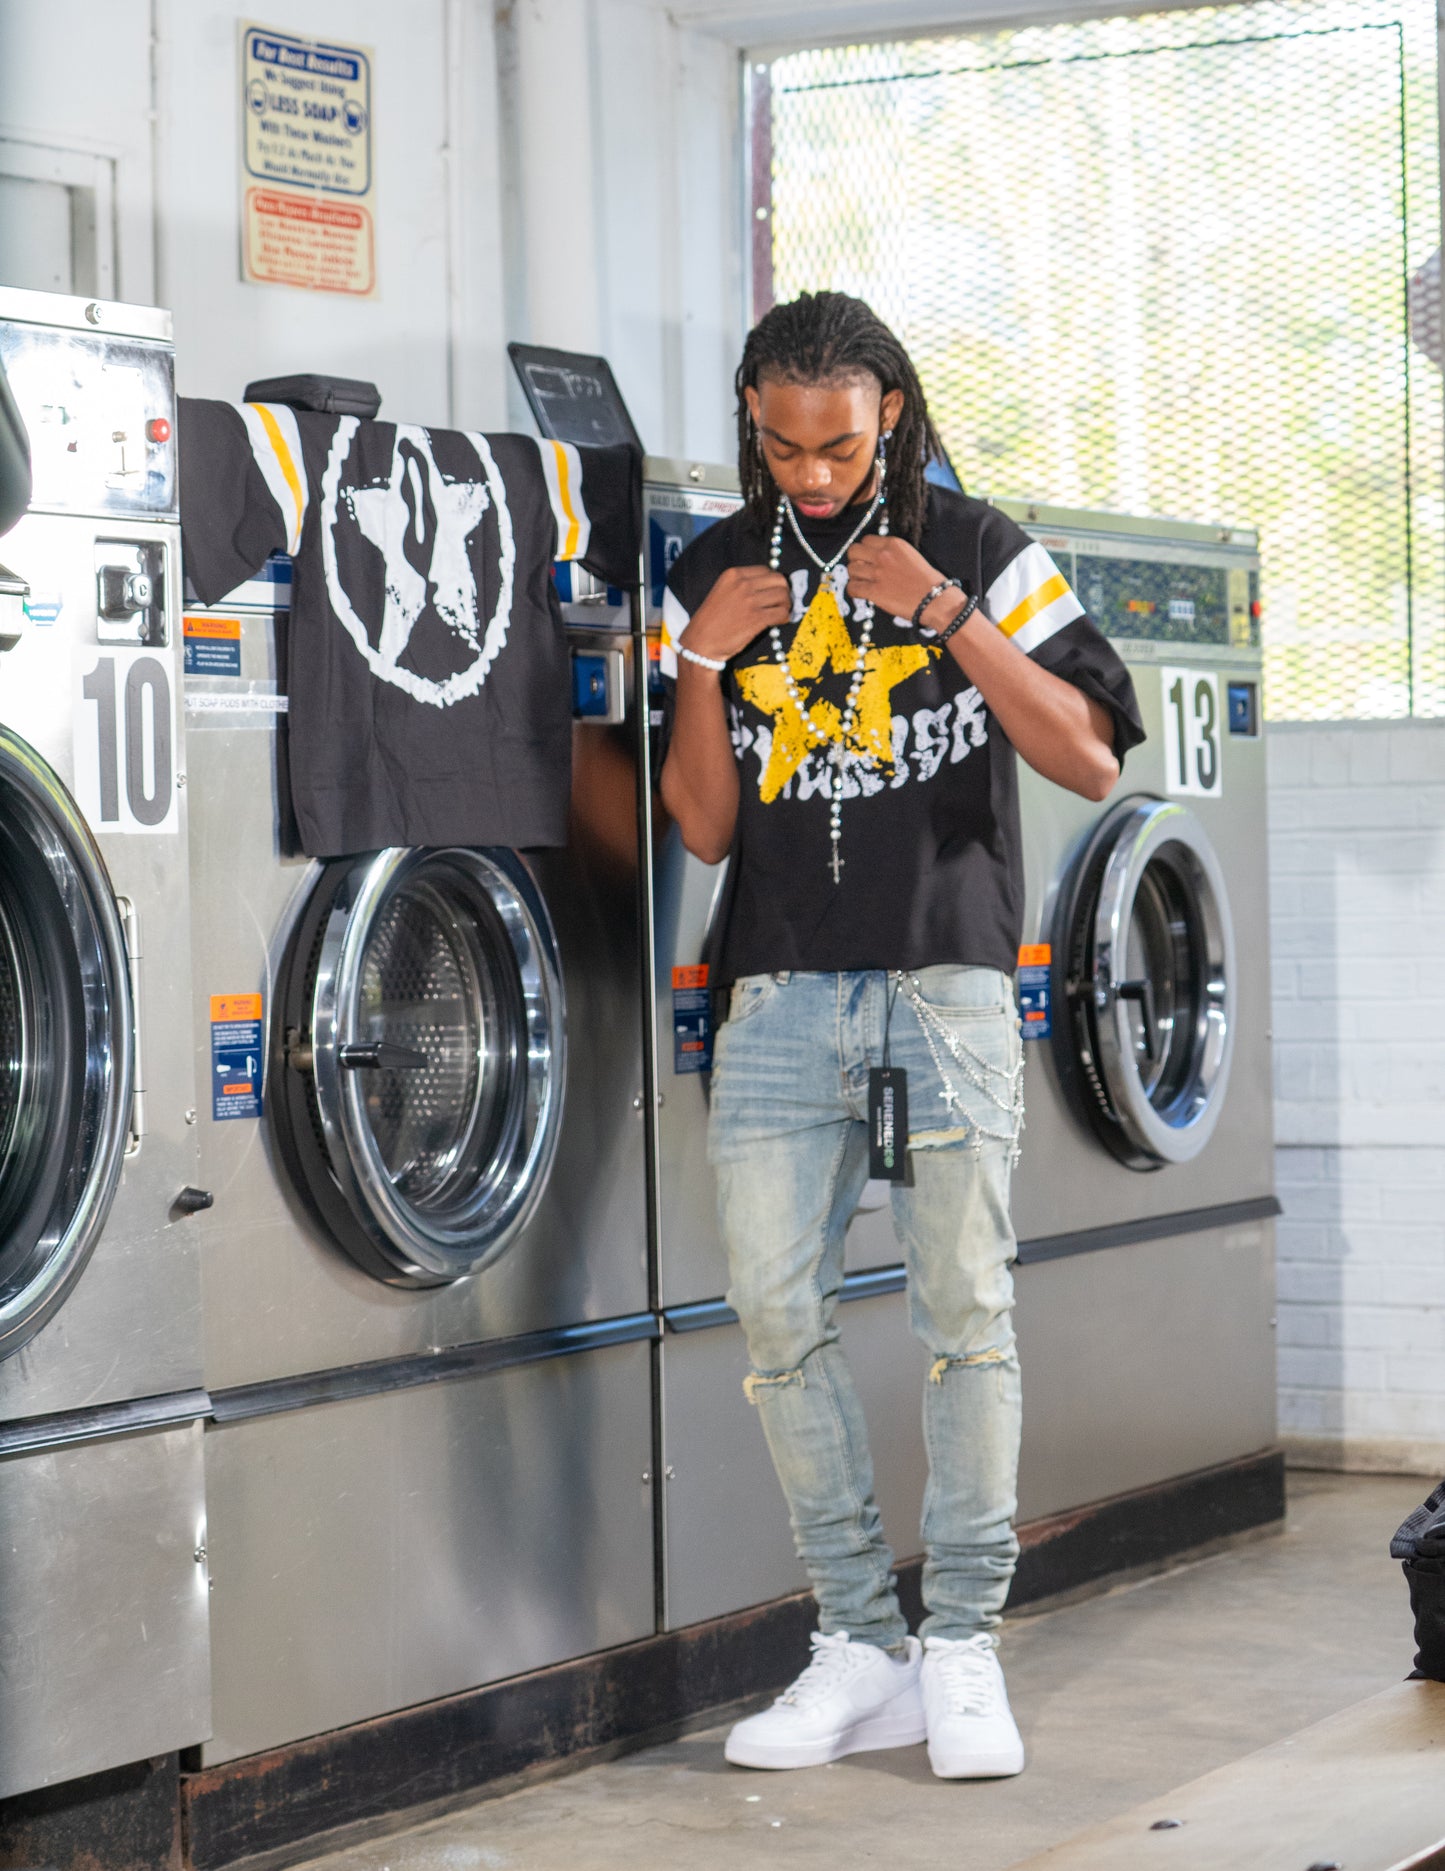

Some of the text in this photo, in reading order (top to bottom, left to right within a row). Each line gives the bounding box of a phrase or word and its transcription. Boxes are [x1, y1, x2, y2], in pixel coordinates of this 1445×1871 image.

[271, 94, 338, 122] LESS SOAP
[83, 657, 172, 826] 10
[1170, 677, 1217, 790] 13
